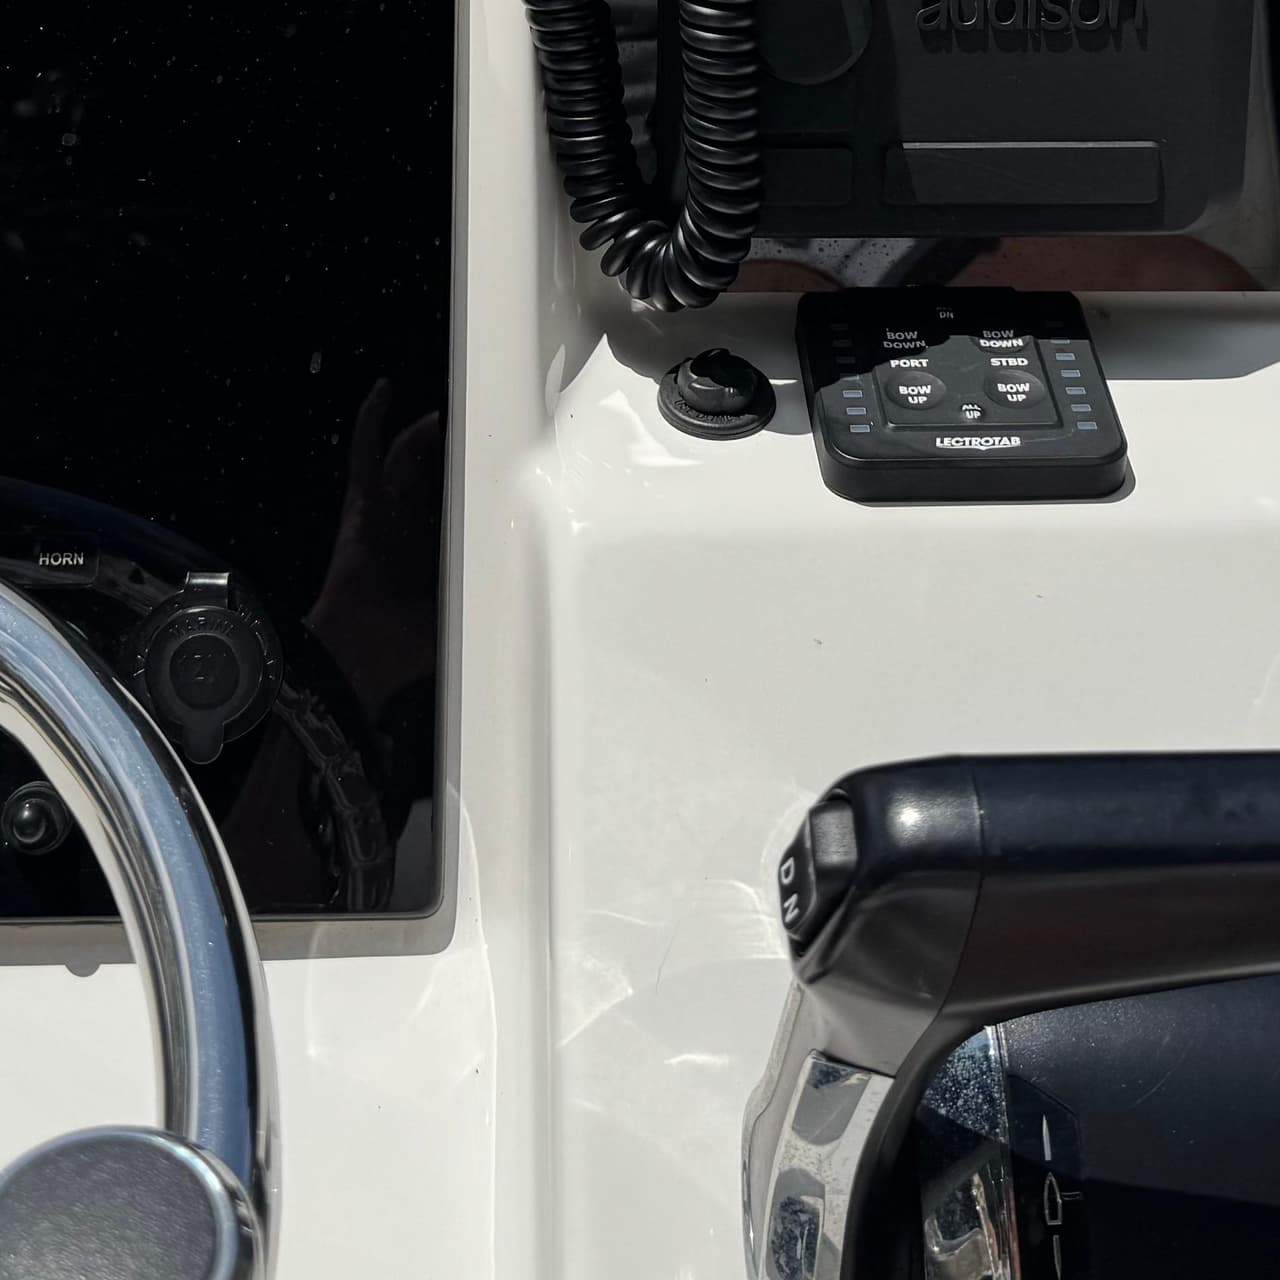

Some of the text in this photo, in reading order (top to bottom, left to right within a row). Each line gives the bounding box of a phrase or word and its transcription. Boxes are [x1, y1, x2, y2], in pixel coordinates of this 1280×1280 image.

[886, 331, 918, 340] BOW
[982, 329, 1015, 339] BOW
[883, 340, 927, 348] DOWN
[980, 338, 1024, 348] DOWN
[889, 358, 929, 368] PORT
[990, 357, 1029, 366] STBD
[898, 384, 932, 395] BOW
[997, 383, 1030, 392] BOW
[908, 396, 928, 404] UP
[1006, 394, 1027, 402] UP
[965, 410, 981, 419] UP
[935, 436, 1021, 449] LECTROTAB
[38, 551, 85, 567] HORN
